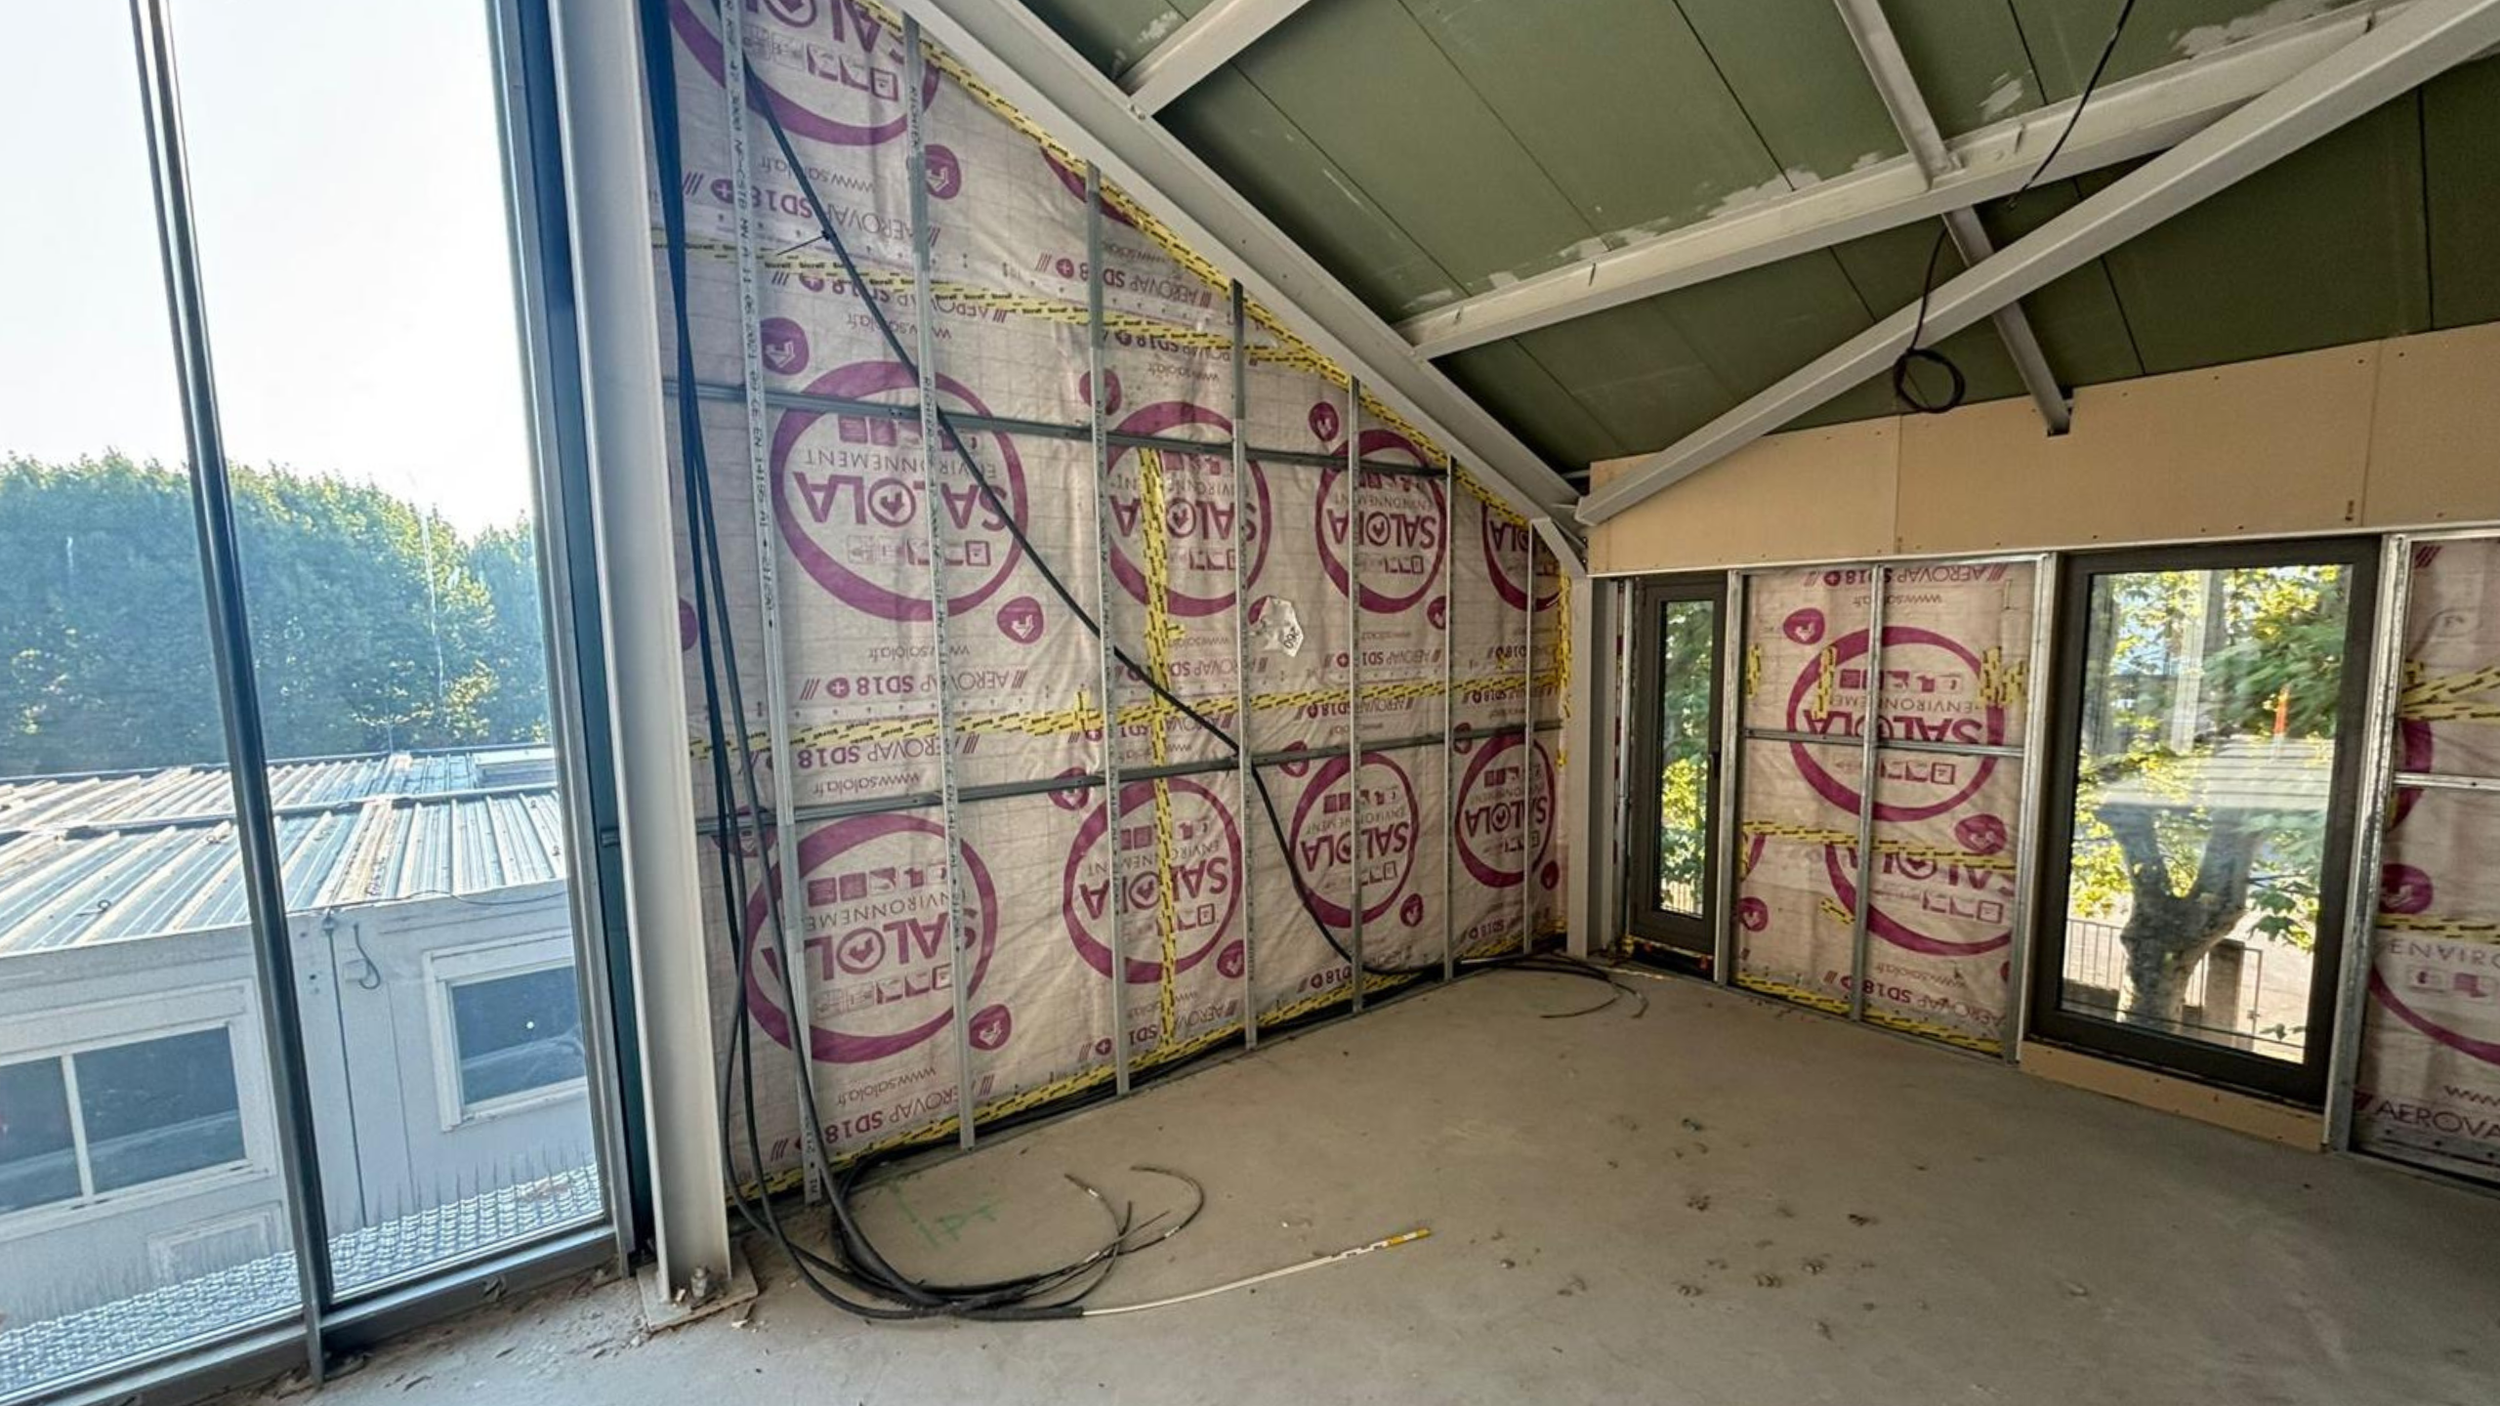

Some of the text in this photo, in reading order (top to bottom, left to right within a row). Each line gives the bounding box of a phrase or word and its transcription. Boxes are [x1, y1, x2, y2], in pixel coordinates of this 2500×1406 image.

[759, 155, 876, 193] www.sala.fr
[1079, 262, 1126, 288] SD8
[846, 312, 952, 340] ww.sala.fr
[803, 449, 996, 479] EVIRNNEMENT
[792, 471, 1008, 532] SAOLA
[1109, 495, 1257, 543] SALOA
[1845, 564, 1988, 585] AEROVAP S18
[856, 675, 914, 696] SD18
[1832, 694, 1974, 714] ENVIRONEME
[797, 746, 861, 769] SD18
[867, 735, 943, 763] EROVAP
[1087, 840, 1221, 877] ENVIRONEMNT
[804, 888, 966, 930] NVIRONNEME
[1325, 966, 1352, 984] D18
[1862, 979, 1914, 1004] SD18
[1128, 1024, 1158, 1046] SD1
[889, 1086, 959, 1123] EROVAP
[824, 1111, 884, 1145] SD18
